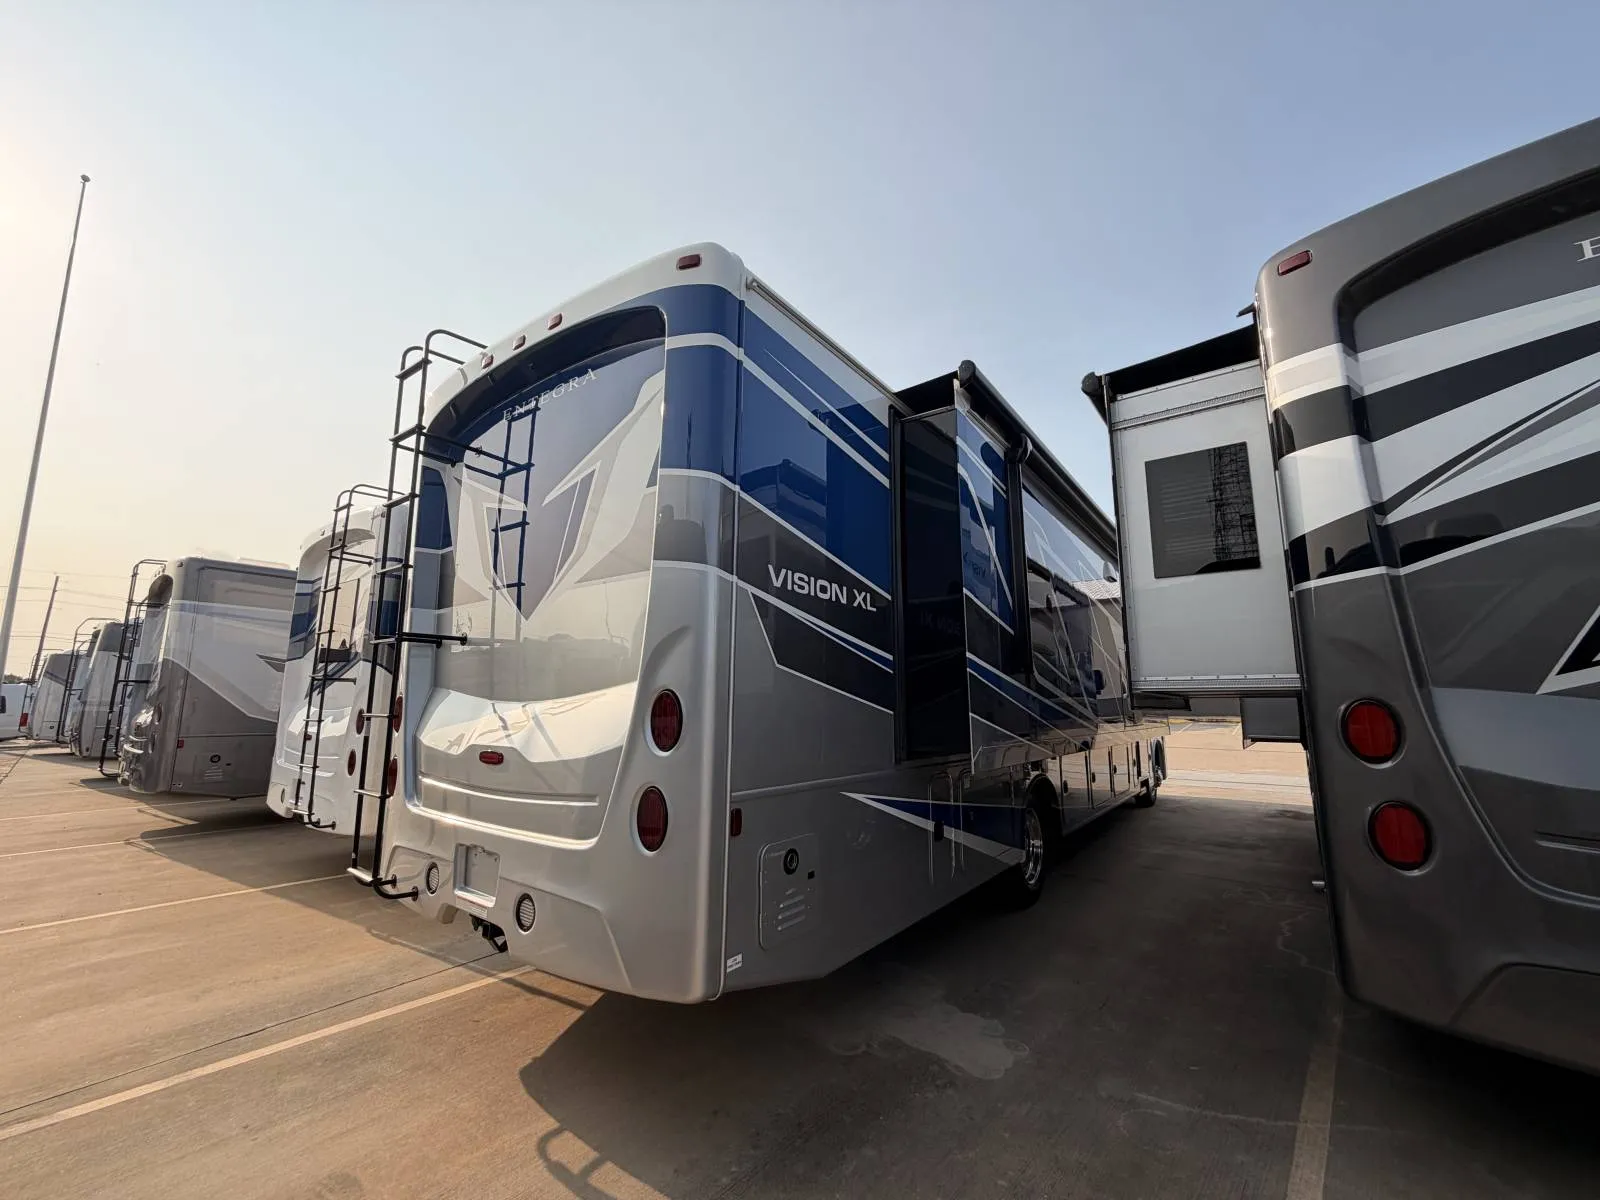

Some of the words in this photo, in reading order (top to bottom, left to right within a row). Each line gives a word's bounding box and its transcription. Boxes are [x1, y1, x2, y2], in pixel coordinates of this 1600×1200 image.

[503, 368, 597, 421] ENTEGRA
[768, 564, 847, 604] VISION
[853, 589, 877, 612] XL
